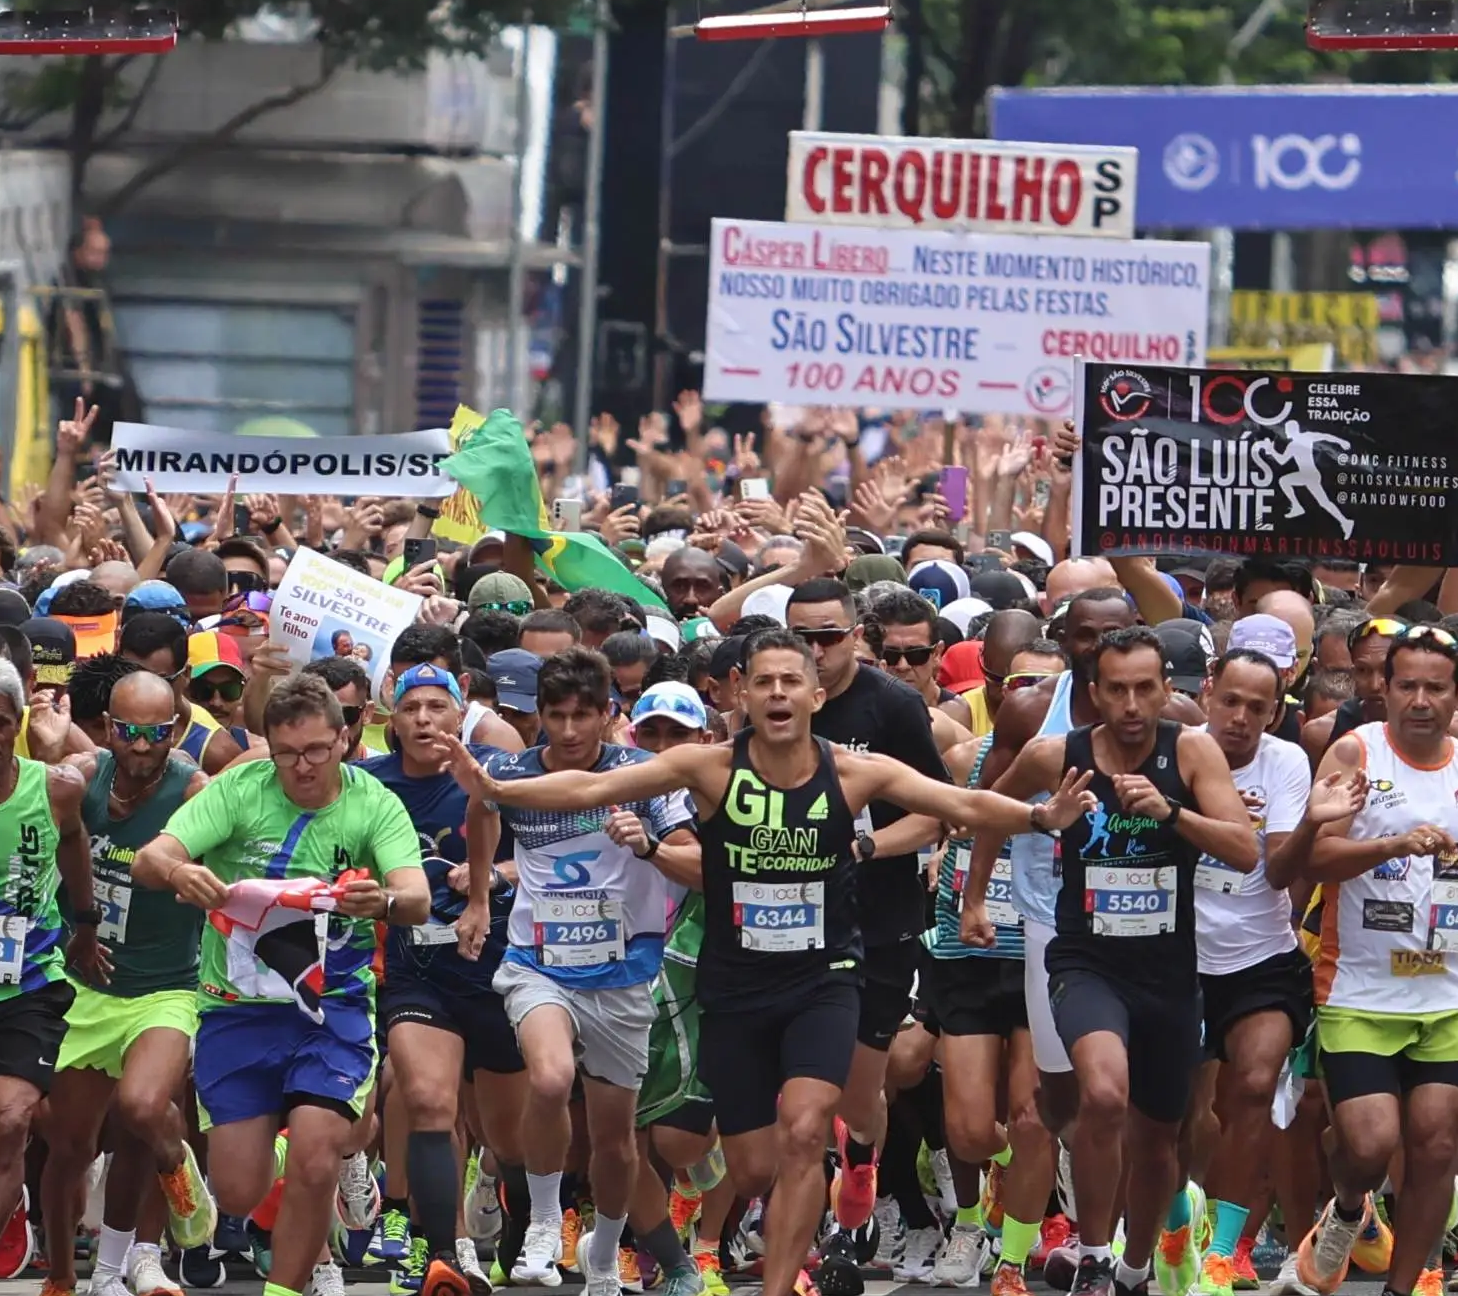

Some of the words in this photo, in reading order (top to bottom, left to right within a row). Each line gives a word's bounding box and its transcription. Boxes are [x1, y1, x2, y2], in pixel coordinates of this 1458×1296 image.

[803, 147, 1081, 225] CERQUILHO
[913, 245, 977, 277] NESTE
[985, 252, 1086, 282] MOMENTO
[1091, 255, 1202, 290] HISTÓRICO,
[719, 271, 785, 299] NOSSO
[791, 276, 853, 305] MUITO
[860, 280, 960, 309] OBRIGADO
[965, 285, 1029, 313] PELAS
[771, 307, 827, 353] SÃO
[835, 311, 979, 361] SILVESTRE
[1042, 329, 1180, 362] CERQUILHO
[786, 362, 844, 391] 100
[853, 365, 961, 397] ANOS
[1308, 382, 1361, 396] CELEBRE
[1308, 396, 1338, 409] ESSA
[1308, 407, 1371, 424] TRADIÇÃO
[1101, 428, 1176, 485] SÃO
[1191, 430, 1275, 487] LUÍS
[1386, 455, 1448, 469] FITNESS
[1099, 485, 1275, 531] PRESENTE
[290, 585, 393, 635] SILVESTRE
[335, 587, 366, 608] SÃO
[280, 605, 291, 618] Te
[293, 612, 318, 627] amo
[282, 621, 308, 639] filho
[726, 768, 783, 830] GI
[751, 825, 818, 856] GAN
[724, 841, 758, 874] TE
[763, 853, 838, 873] CORRIDAS
[754, 907, 807, 927] 6344
[1108, 895, 1160, 912] 5540
[557, 924, 608, 943] 2496
